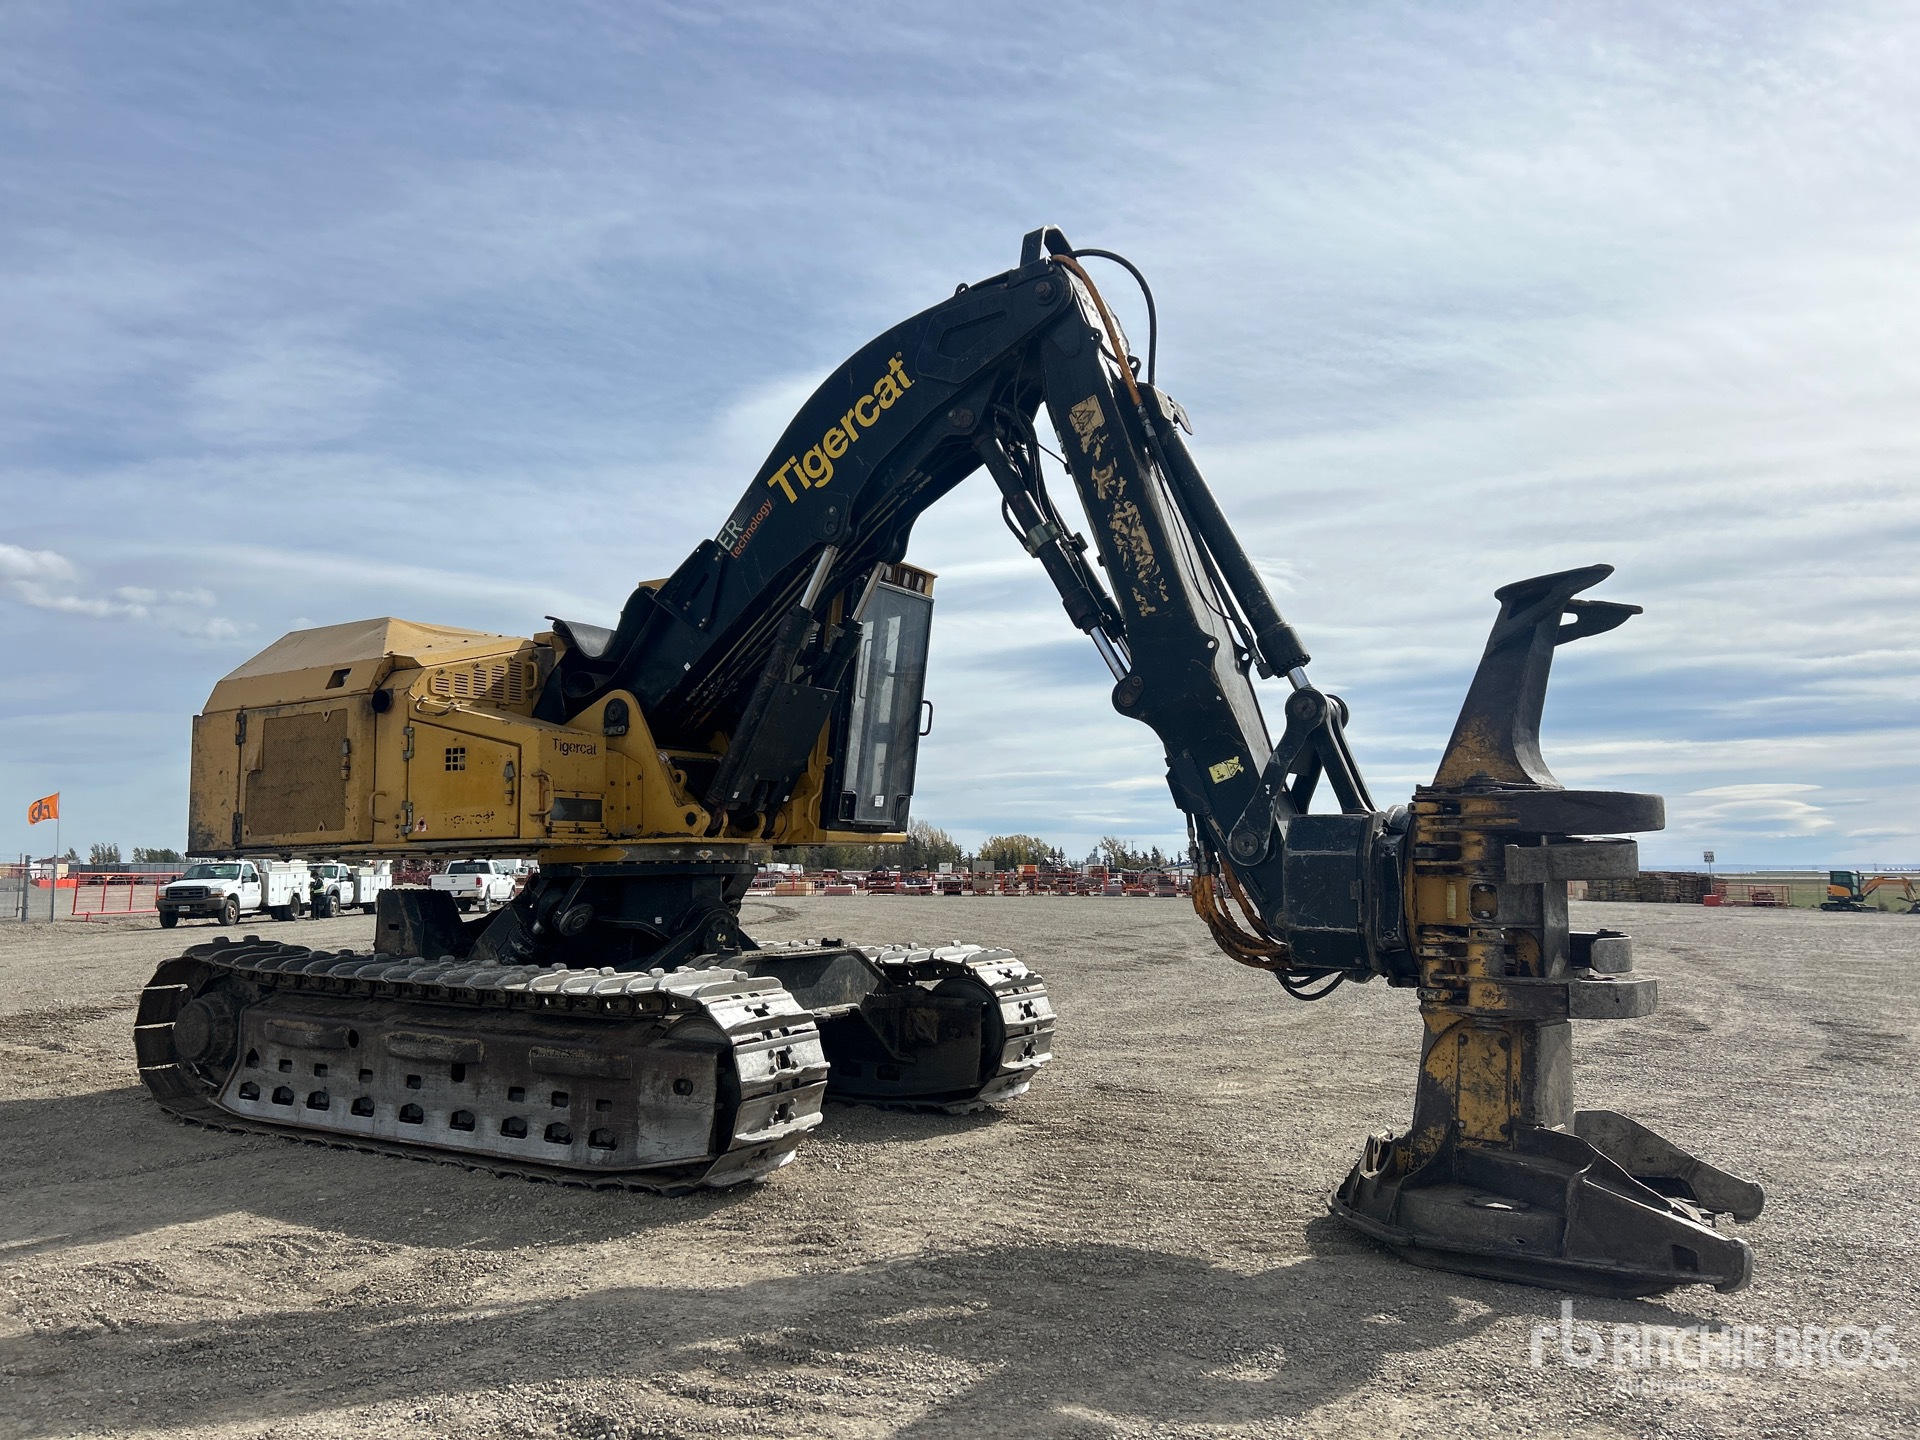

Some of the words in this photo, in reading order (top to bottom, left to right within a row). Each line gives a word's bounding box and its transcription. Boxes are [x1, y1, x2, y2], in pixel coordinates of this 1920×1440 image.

[767, 352, 915, 504] Tigercat
[717, 519, 744, 551] ER
[730, 498, 773, 559] technology
[552, 738, 597, 756] Tigercat
